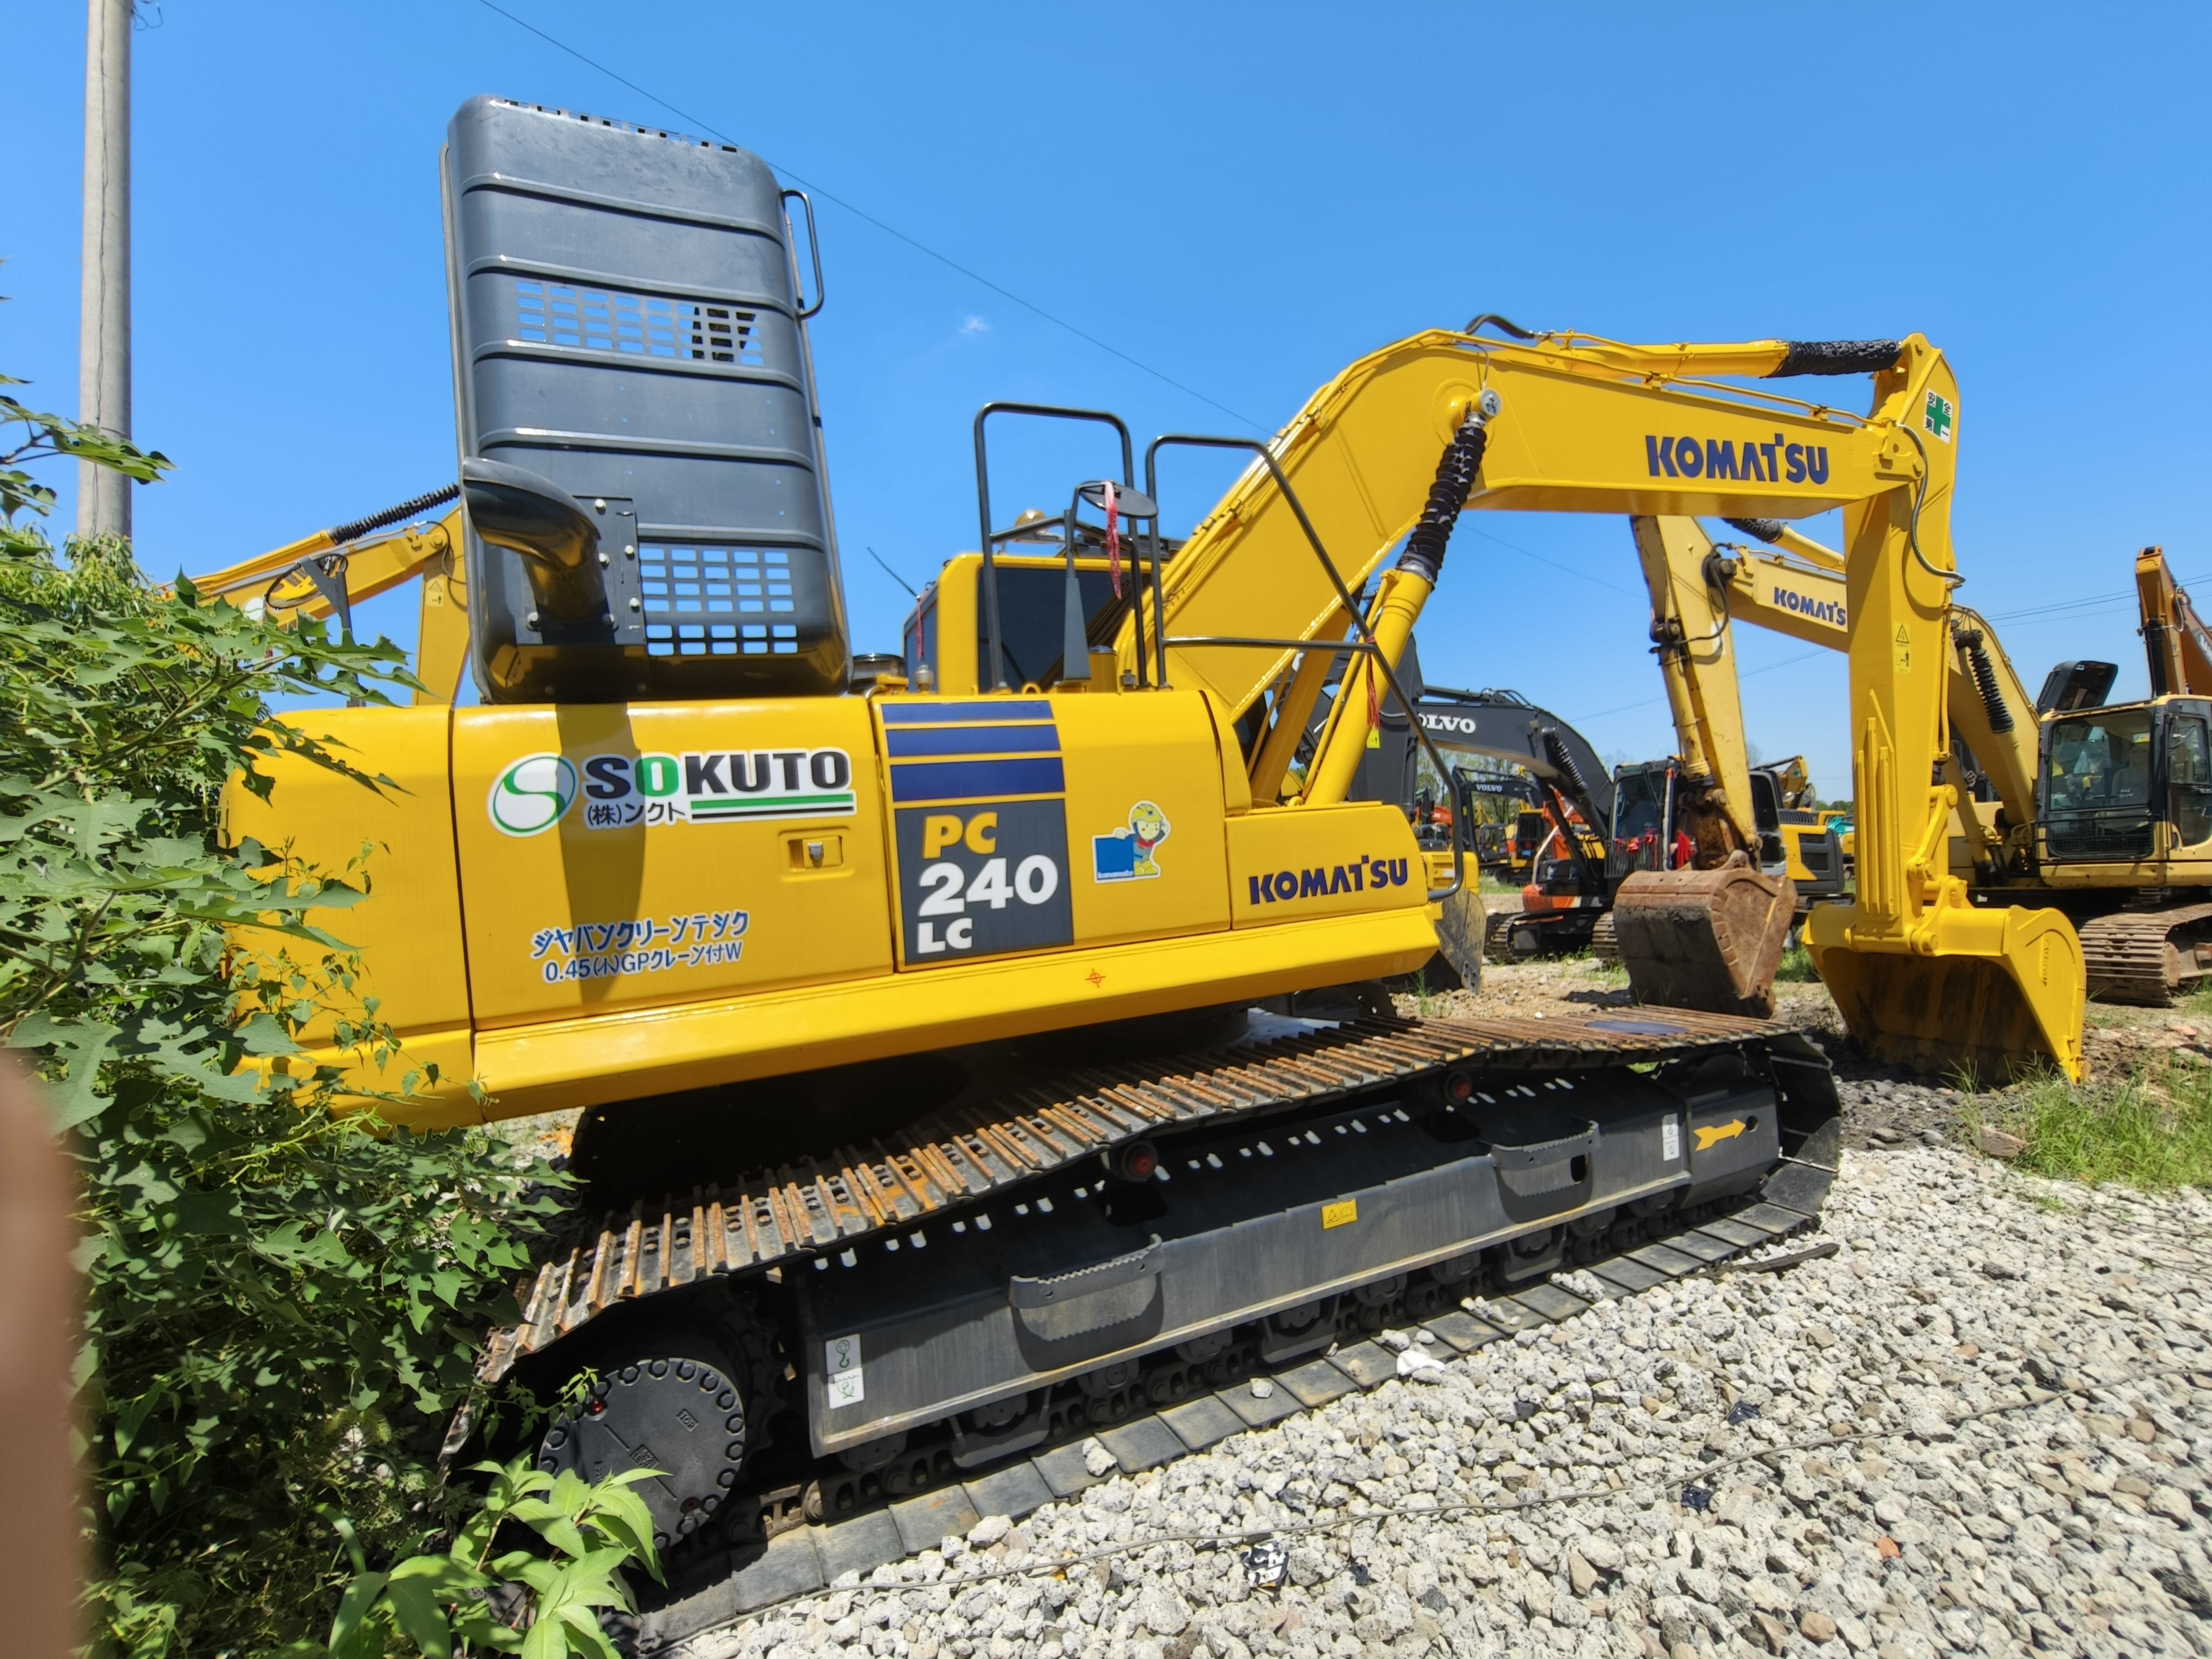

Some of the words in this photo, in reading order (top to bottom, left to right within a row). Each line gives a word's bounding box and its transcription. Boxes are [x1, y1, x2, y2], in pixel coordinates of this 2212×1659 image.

[1645, 433, 1829, 484] KOMATSU
[1774, 586, 1846, 626] KOMATS
[1418, 713, 1476, 734] OLVO
[586, 751, 848, 799] SOKUTO
[1476, 784, 1502, 792] VOLVO
[923, 811, 998, 859] PC
[919, 854, 1058, 916] 240
[1249, 855, 1408, 905] KOMATSU
[918, 918, 972, 954] LC
